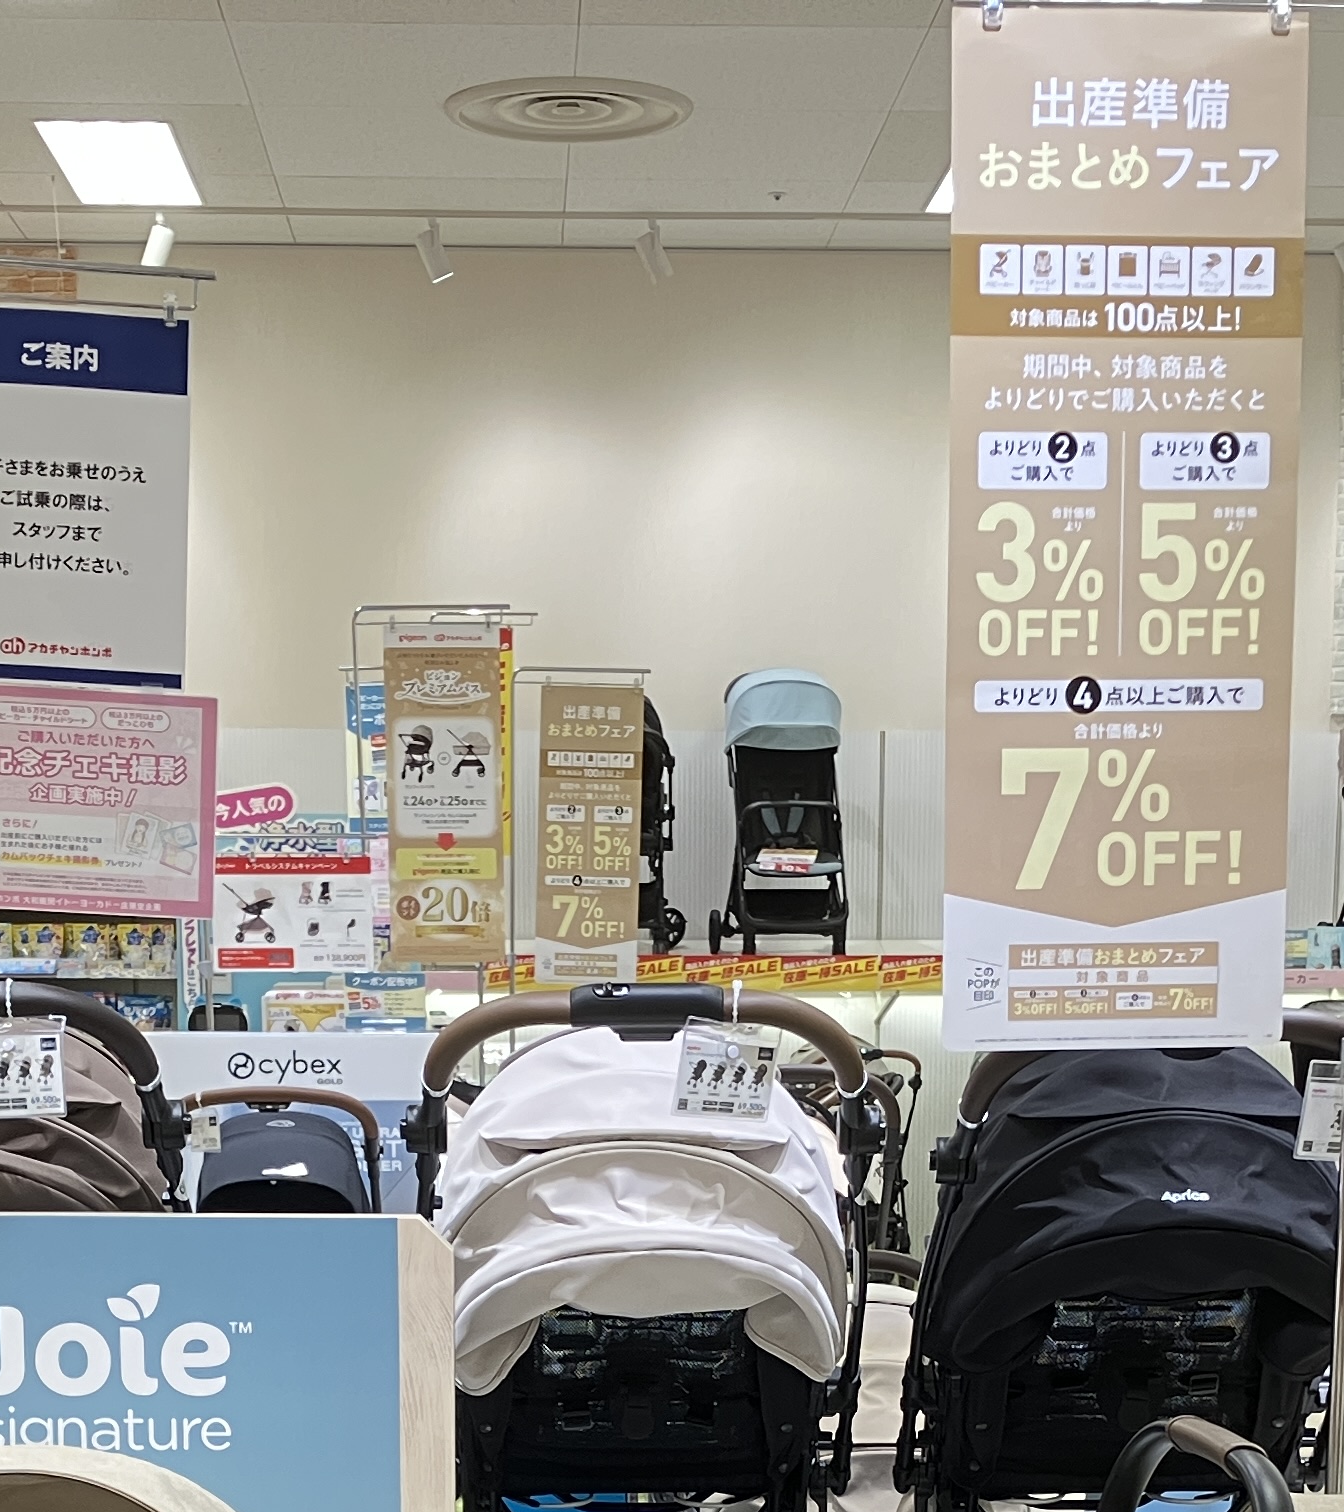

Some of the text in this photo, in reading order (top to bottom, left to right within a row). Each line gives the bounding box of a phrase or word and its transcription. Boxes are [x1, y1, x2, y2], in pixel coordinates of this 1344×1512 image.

[1032, 77, 1229, 129] 出産準備
[979, 142, 1279, 190] おまとめフェア
[20, 342, 99, 372] ご案内
[1023, 354, 1228, 380] 期間中、対象商品を
[985, 387, 1265, 412] よりどりでご購入いただくと
[1011, 465, 1074, 482] ご購入で
[1172, 465, 1236, 482] ご購入で
[0, 490, 111, 513] ご試乗の際は、
[11, 521, 103, 543] スタッフまで
[978, 608, 1099, 657] OFF!
[1139, 607, 1260, 656] OFF!
[18, 730, 154, 749] ご購入いただいた方へ
[548, 723, 636, 738] おまとめフェア
[546, 856, 583, 870] OFF!
[593, 857, 630, 871] OFF!
[1097, 830, 1242, 886] OFF!
[580, 921, 625, 939] OFF!
[259, 1050, 341, 1084] cybex
